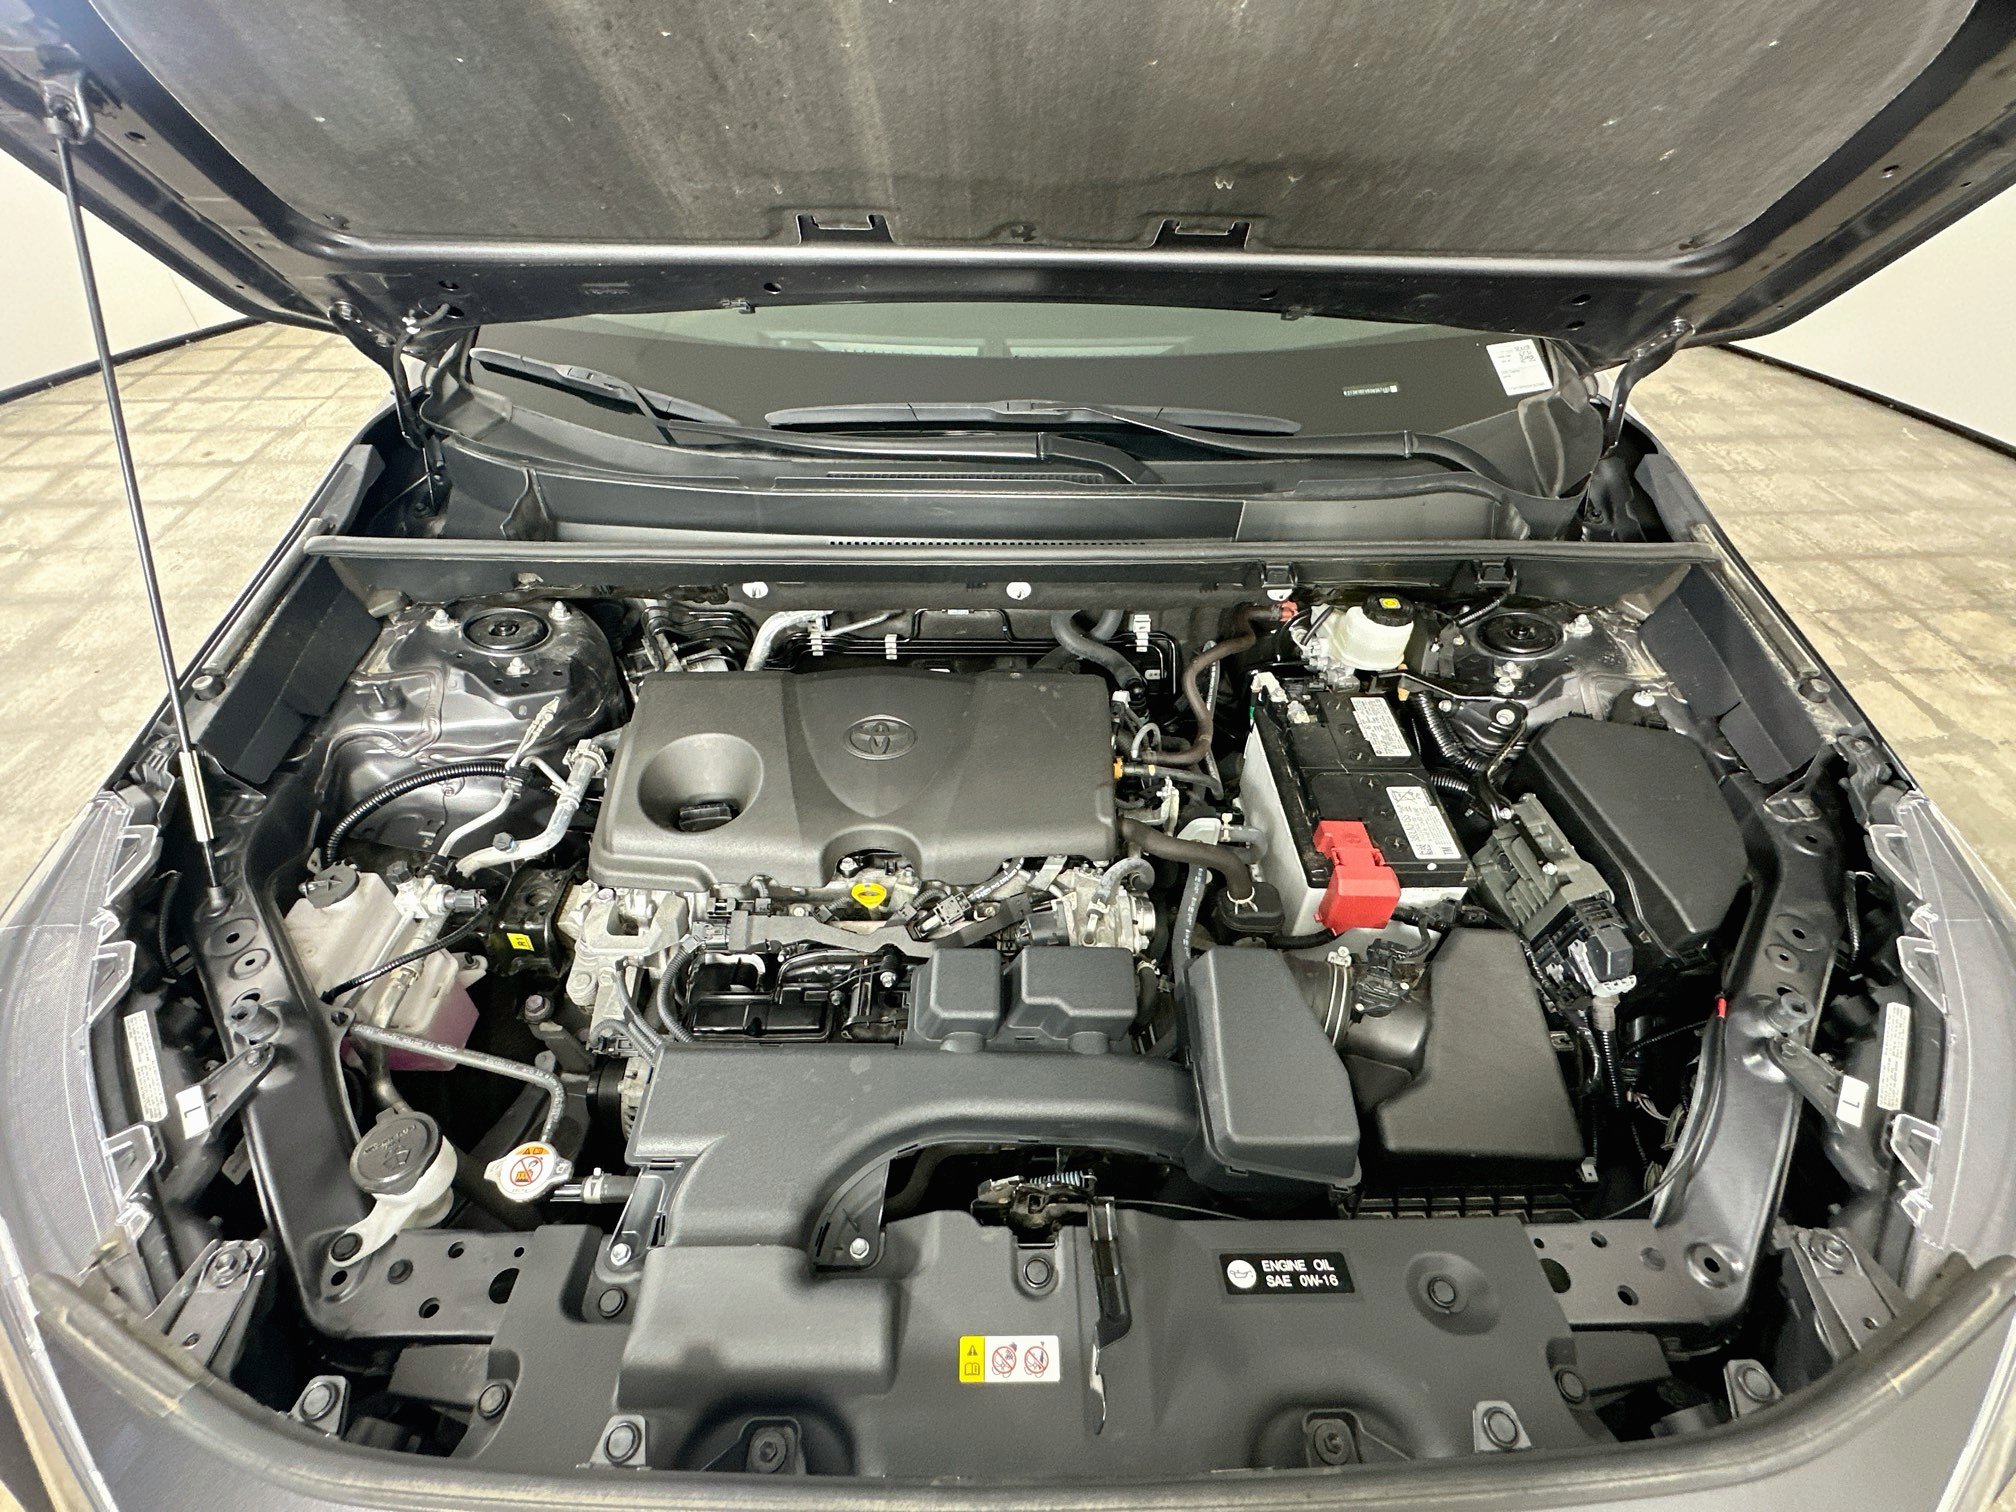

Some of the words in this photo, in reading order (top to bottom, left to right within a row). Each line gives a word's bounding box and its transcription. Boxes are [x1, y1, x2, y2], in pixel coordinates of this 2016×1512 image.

[1261, 1259, 1307, 1272] ENGINE
[1313, 1258, 1335, 1272] OIL
[1265, 1275, 1293, 1288] SAE
[1299, 1274, 1339, 1287] 0W-16
